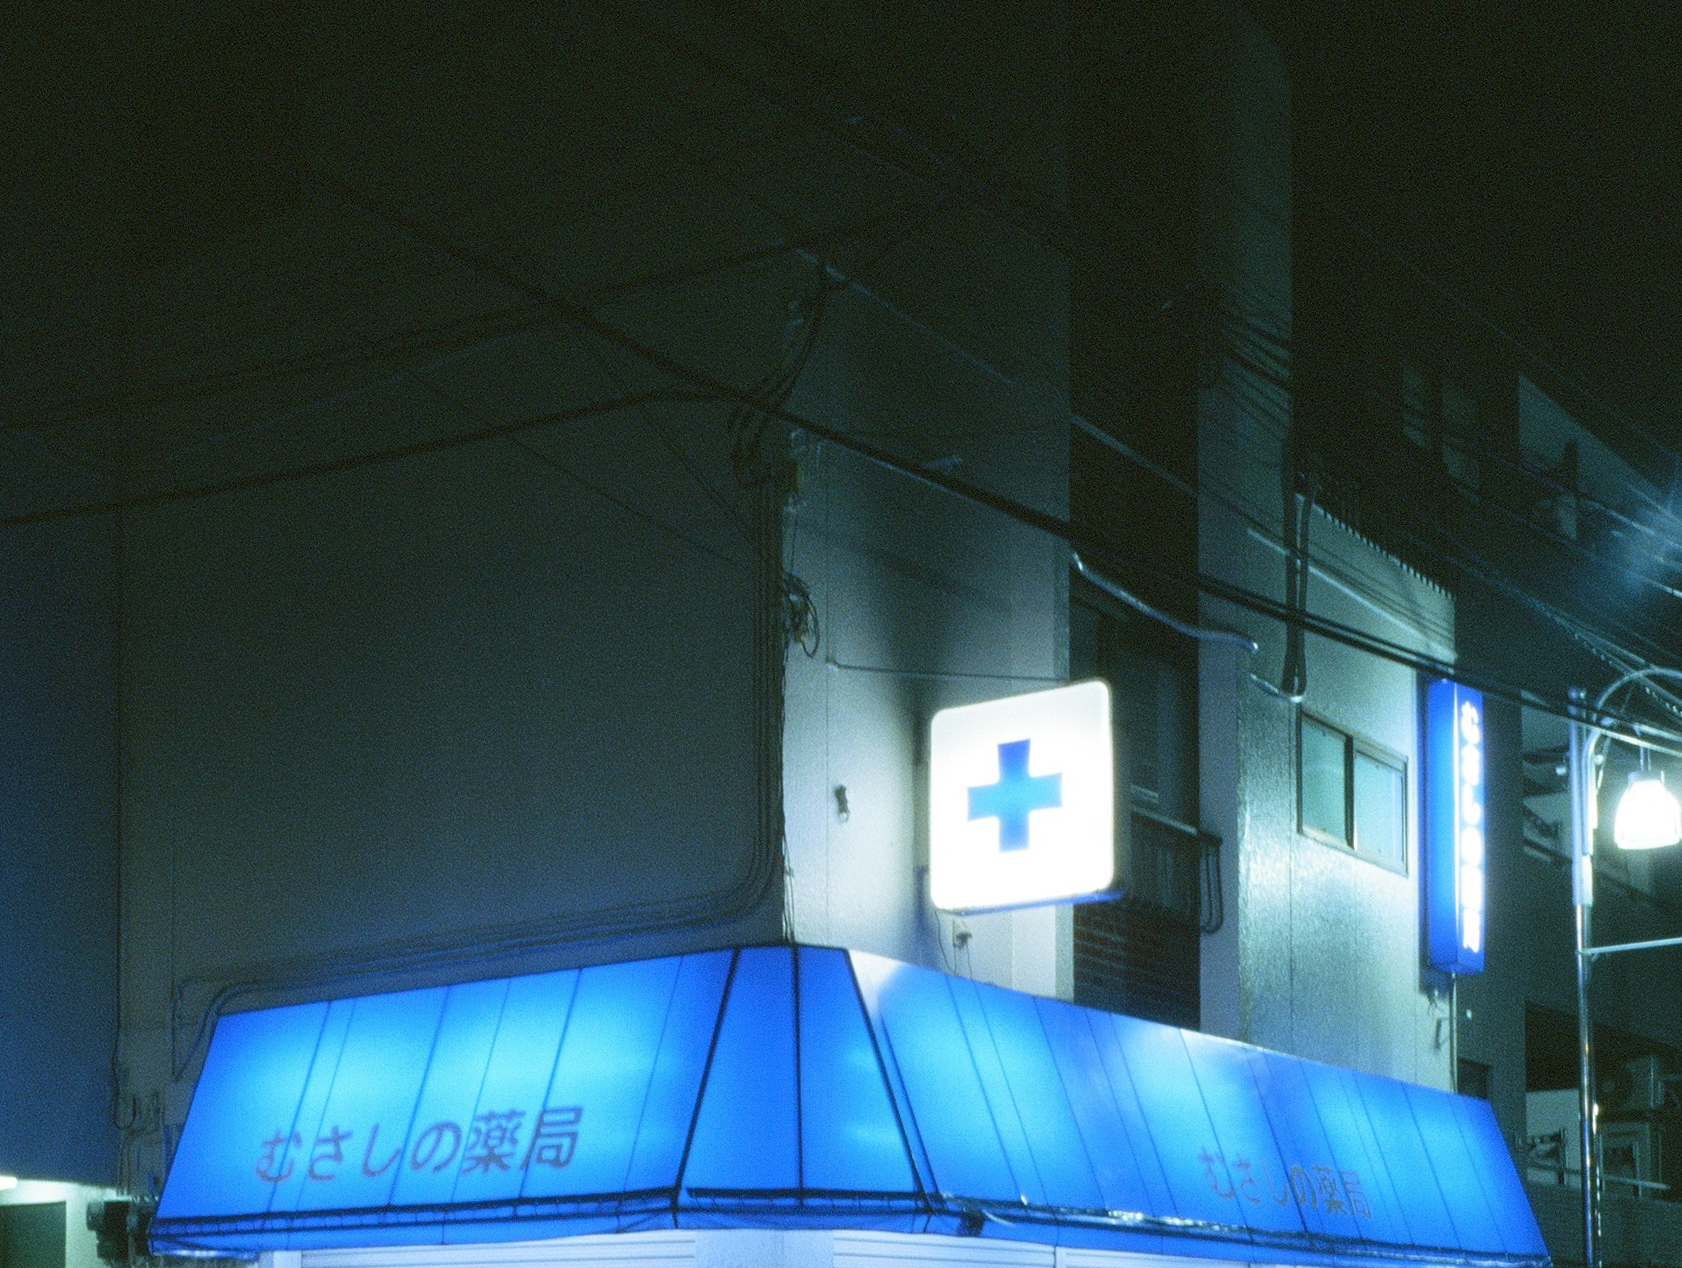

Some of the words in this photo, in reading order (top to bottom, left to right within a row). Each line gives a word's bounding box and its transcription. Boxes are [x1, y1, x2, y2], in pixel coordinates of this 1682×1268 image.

[254, 1105, 582, 1184] むさしの薬局
[1199, 1147, 1371, 1219] むさしの薬局
